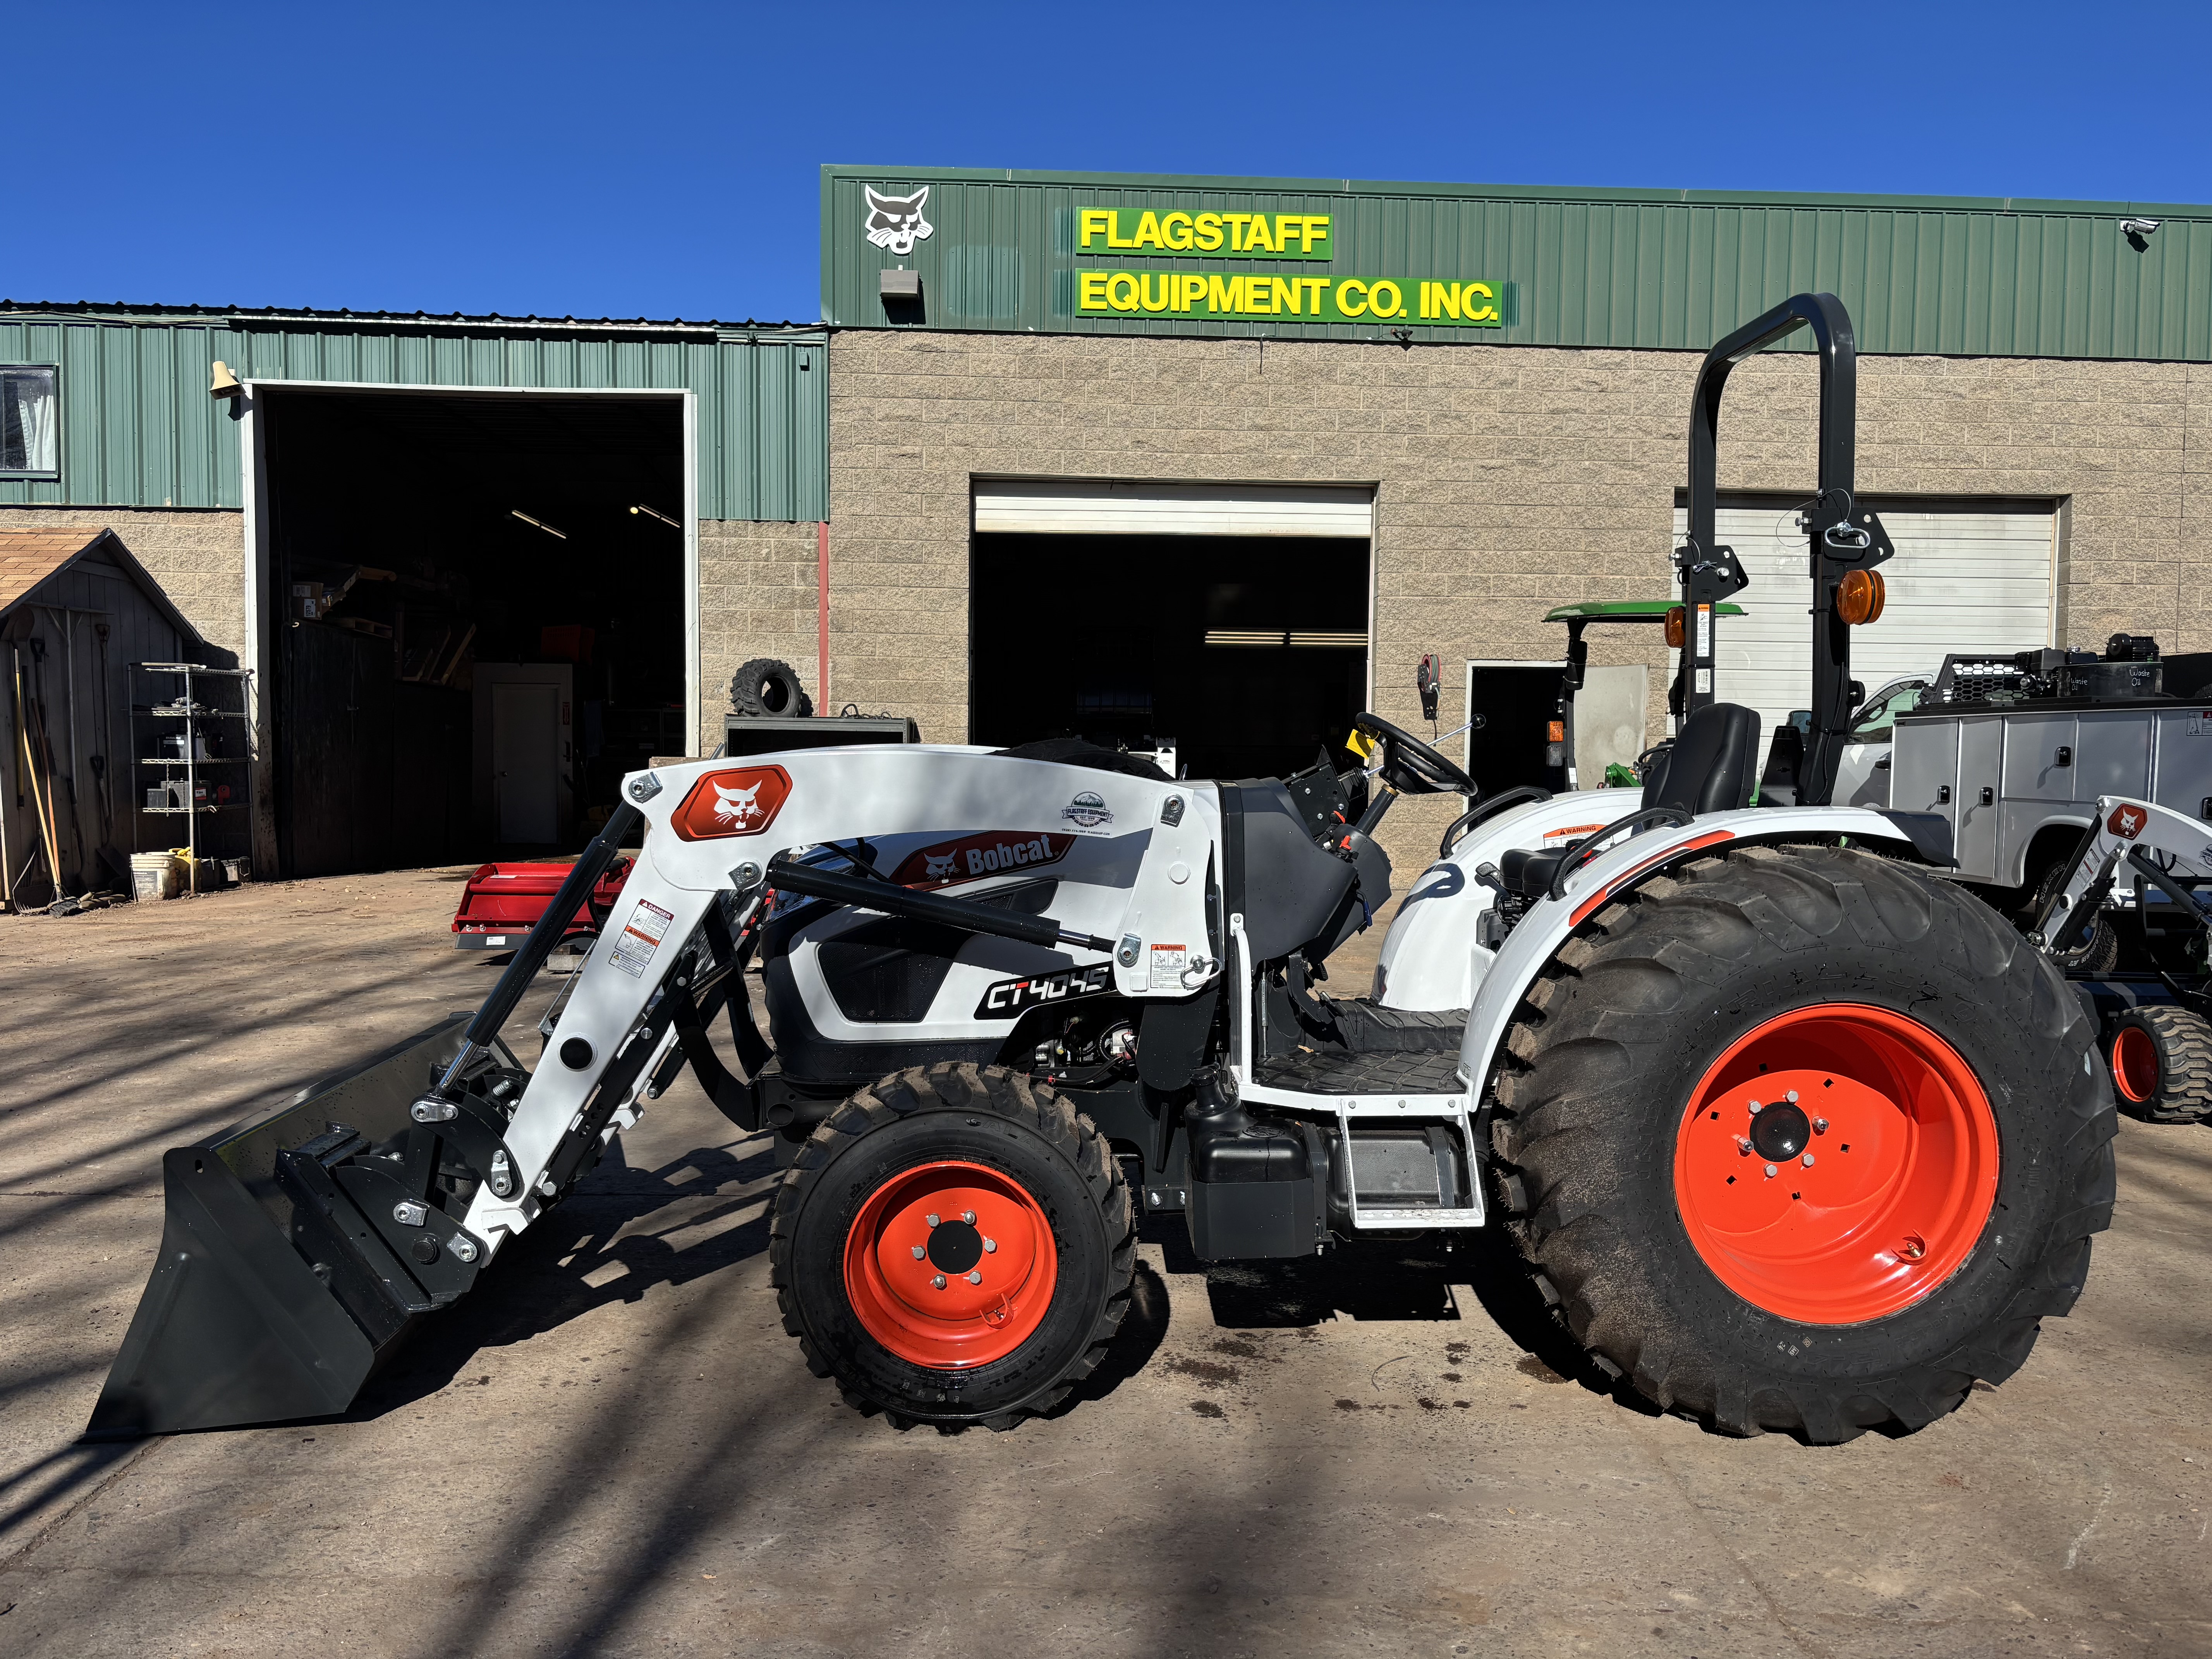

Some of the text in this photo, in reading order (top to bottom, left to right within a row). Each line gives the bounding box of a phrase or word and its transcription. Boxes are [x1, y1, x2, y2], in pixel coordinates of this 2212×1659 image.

[1081, 210, 1329, 253] FLAGSTAFF
[1080, 273, 1498, 321] EQUIPMENT CO. INC.
[2129, 668, 2150, 677] Waste
[2071, 677, 2088, 685] Waste
[2131, 677, 2141, 686] Oil
[1087, 809, 1108, 817] EQUIPMENT
[1566, 826, 1596, 834] WARNING
[965, 834, 1053, 875] Bobcat
[2039, 863, 2066, 903] NEXEN
[647, 904, 671, 919] DANGER
[633, 929, 656, 945] WARNING
[987, 966, 1109, 1010] CT4045
[965, 1117, 1070, 1173] GALAXY
